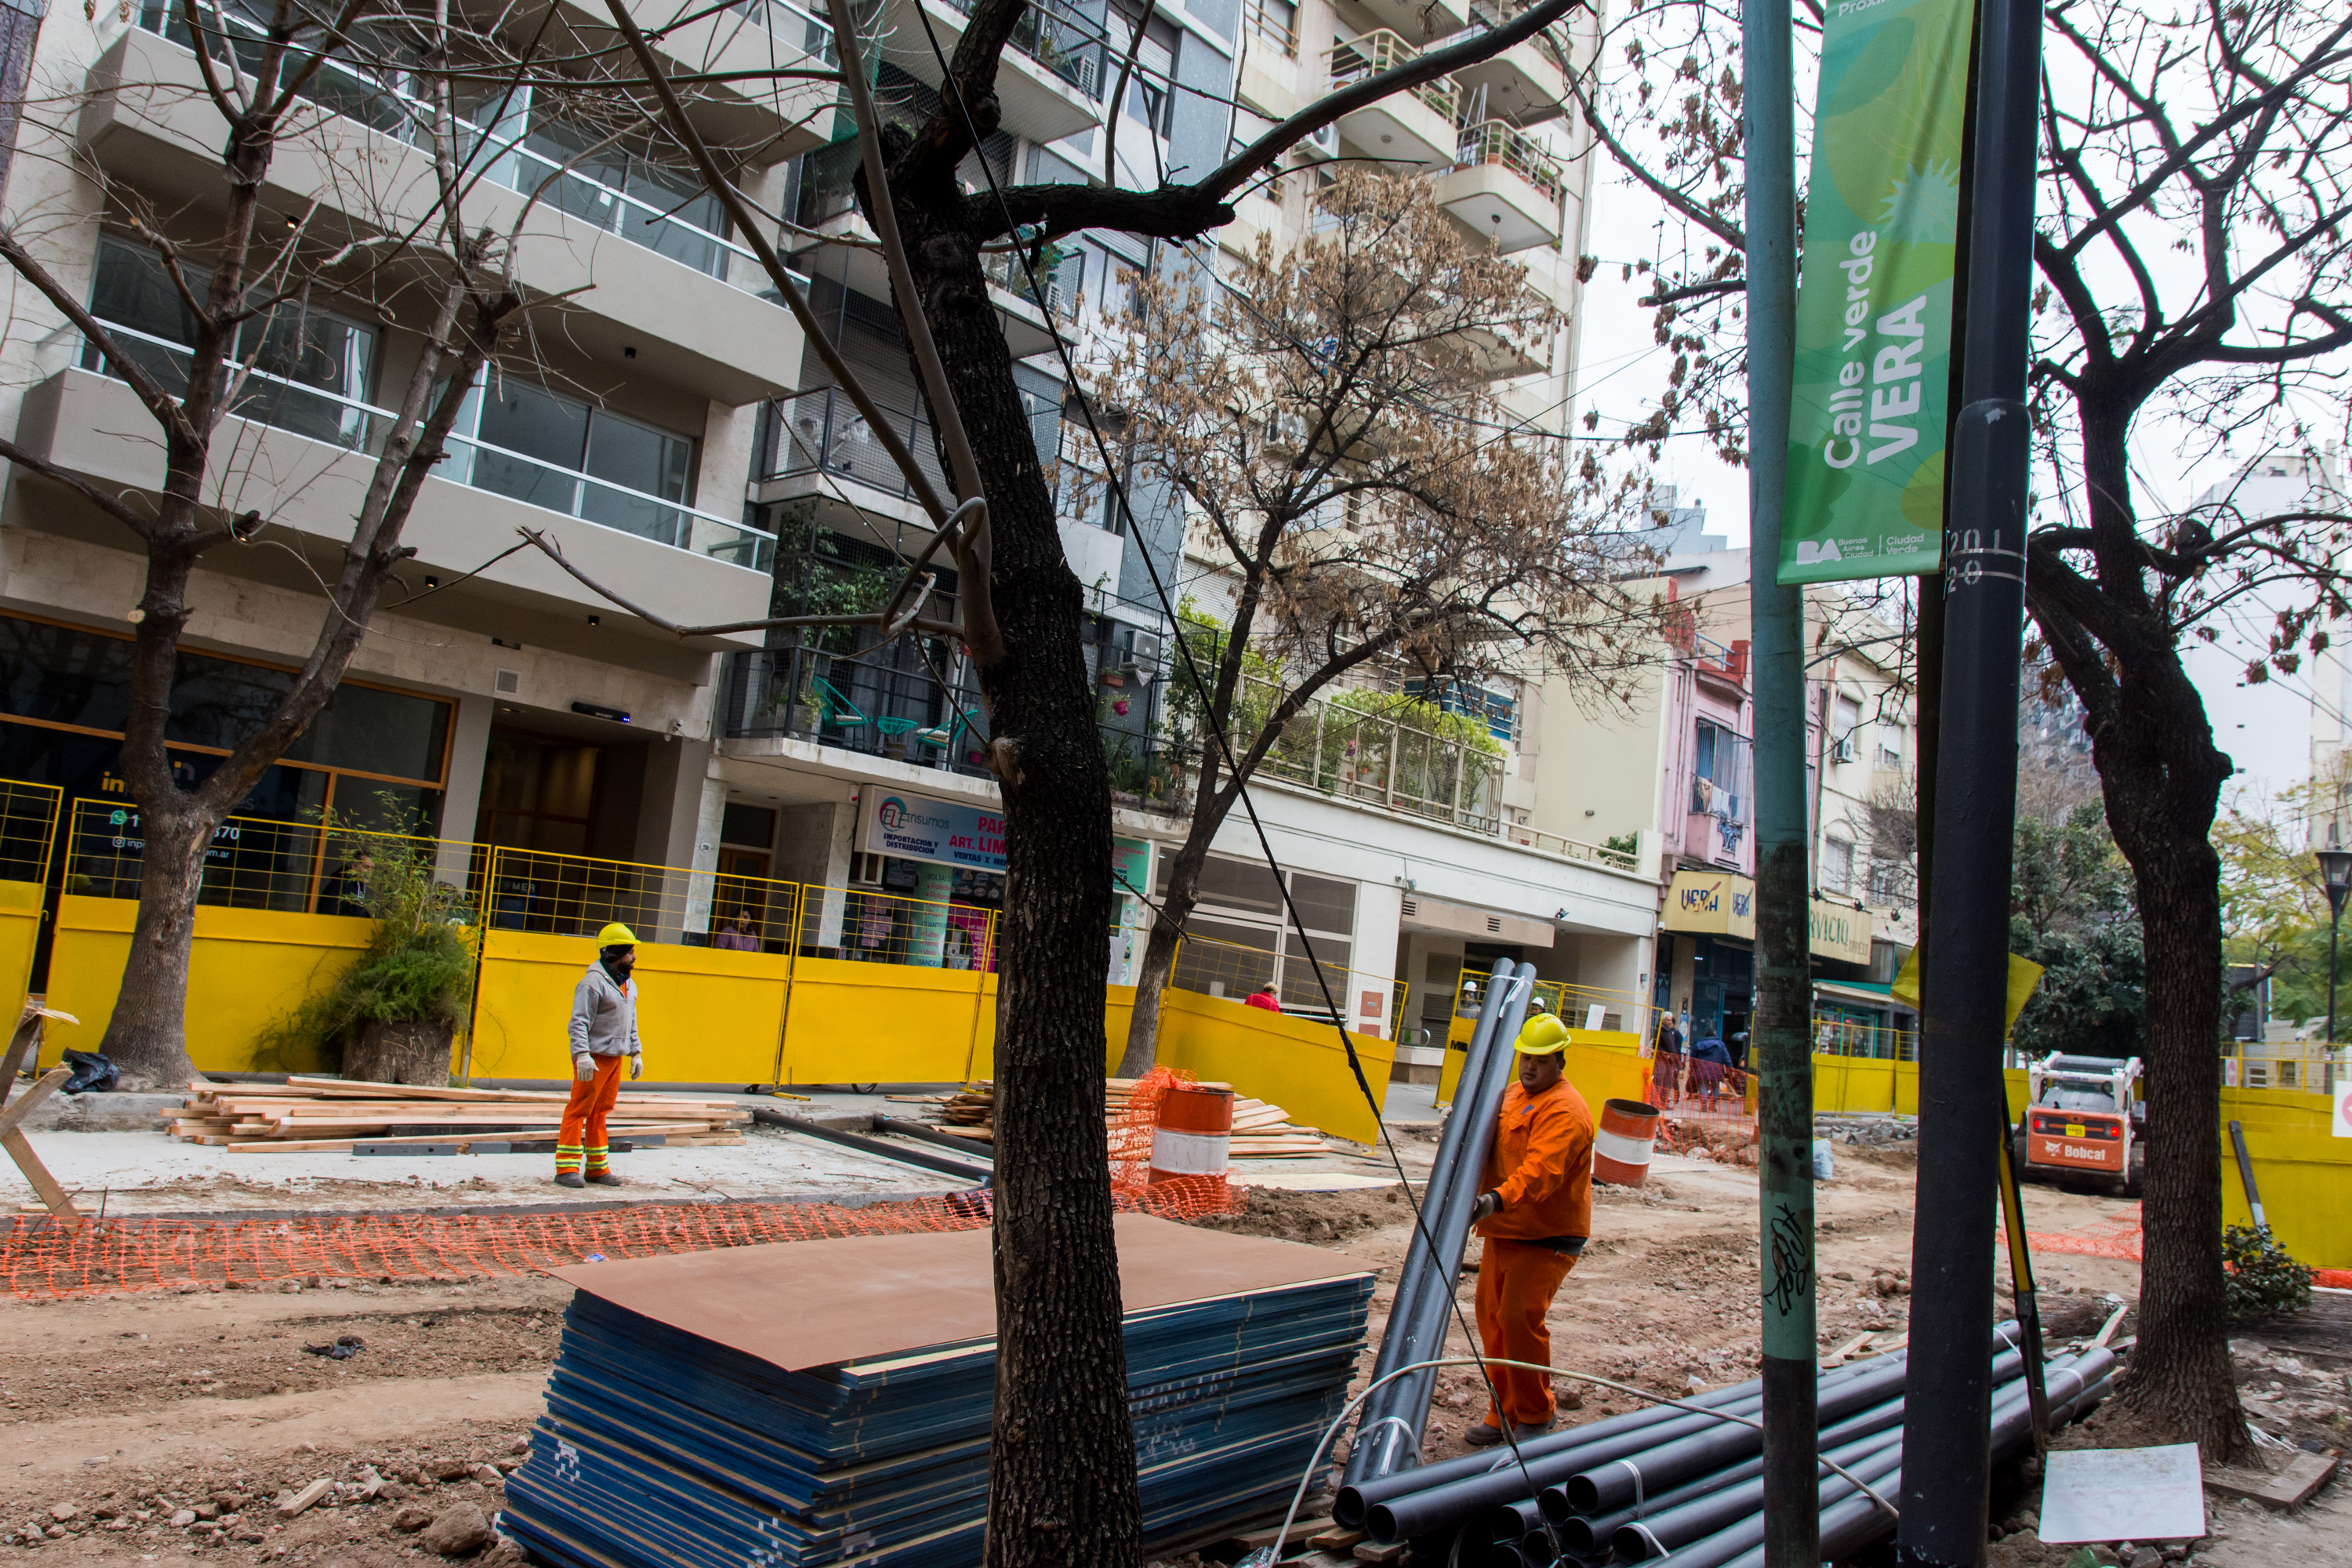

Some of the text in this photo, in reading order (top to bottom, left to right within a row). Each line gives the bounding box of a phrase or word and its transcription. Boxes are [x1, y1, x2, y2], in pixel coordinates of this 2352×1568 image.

[1824, 230, 1877, 470] Calle verde
[1866, 294, 1927, 466] VERA
[1838, 537, 1867, 546] Buenos
[1886, 533, 1924, 546] Ciudad
[1845, 550, 1874, 559] Ciudad
[1886, 545, 1918, 556] Verde
[101, 771, 126, 793] in
[884, 833, 932, 847] IMPORTACION
[949, 835, 975, 850] ART.
[886, 840, 935, 855] DISTRIBUCION
[953, 851, 982, 862] VENTAS
[2064, 1145, 2106, 1160] Bobcat
